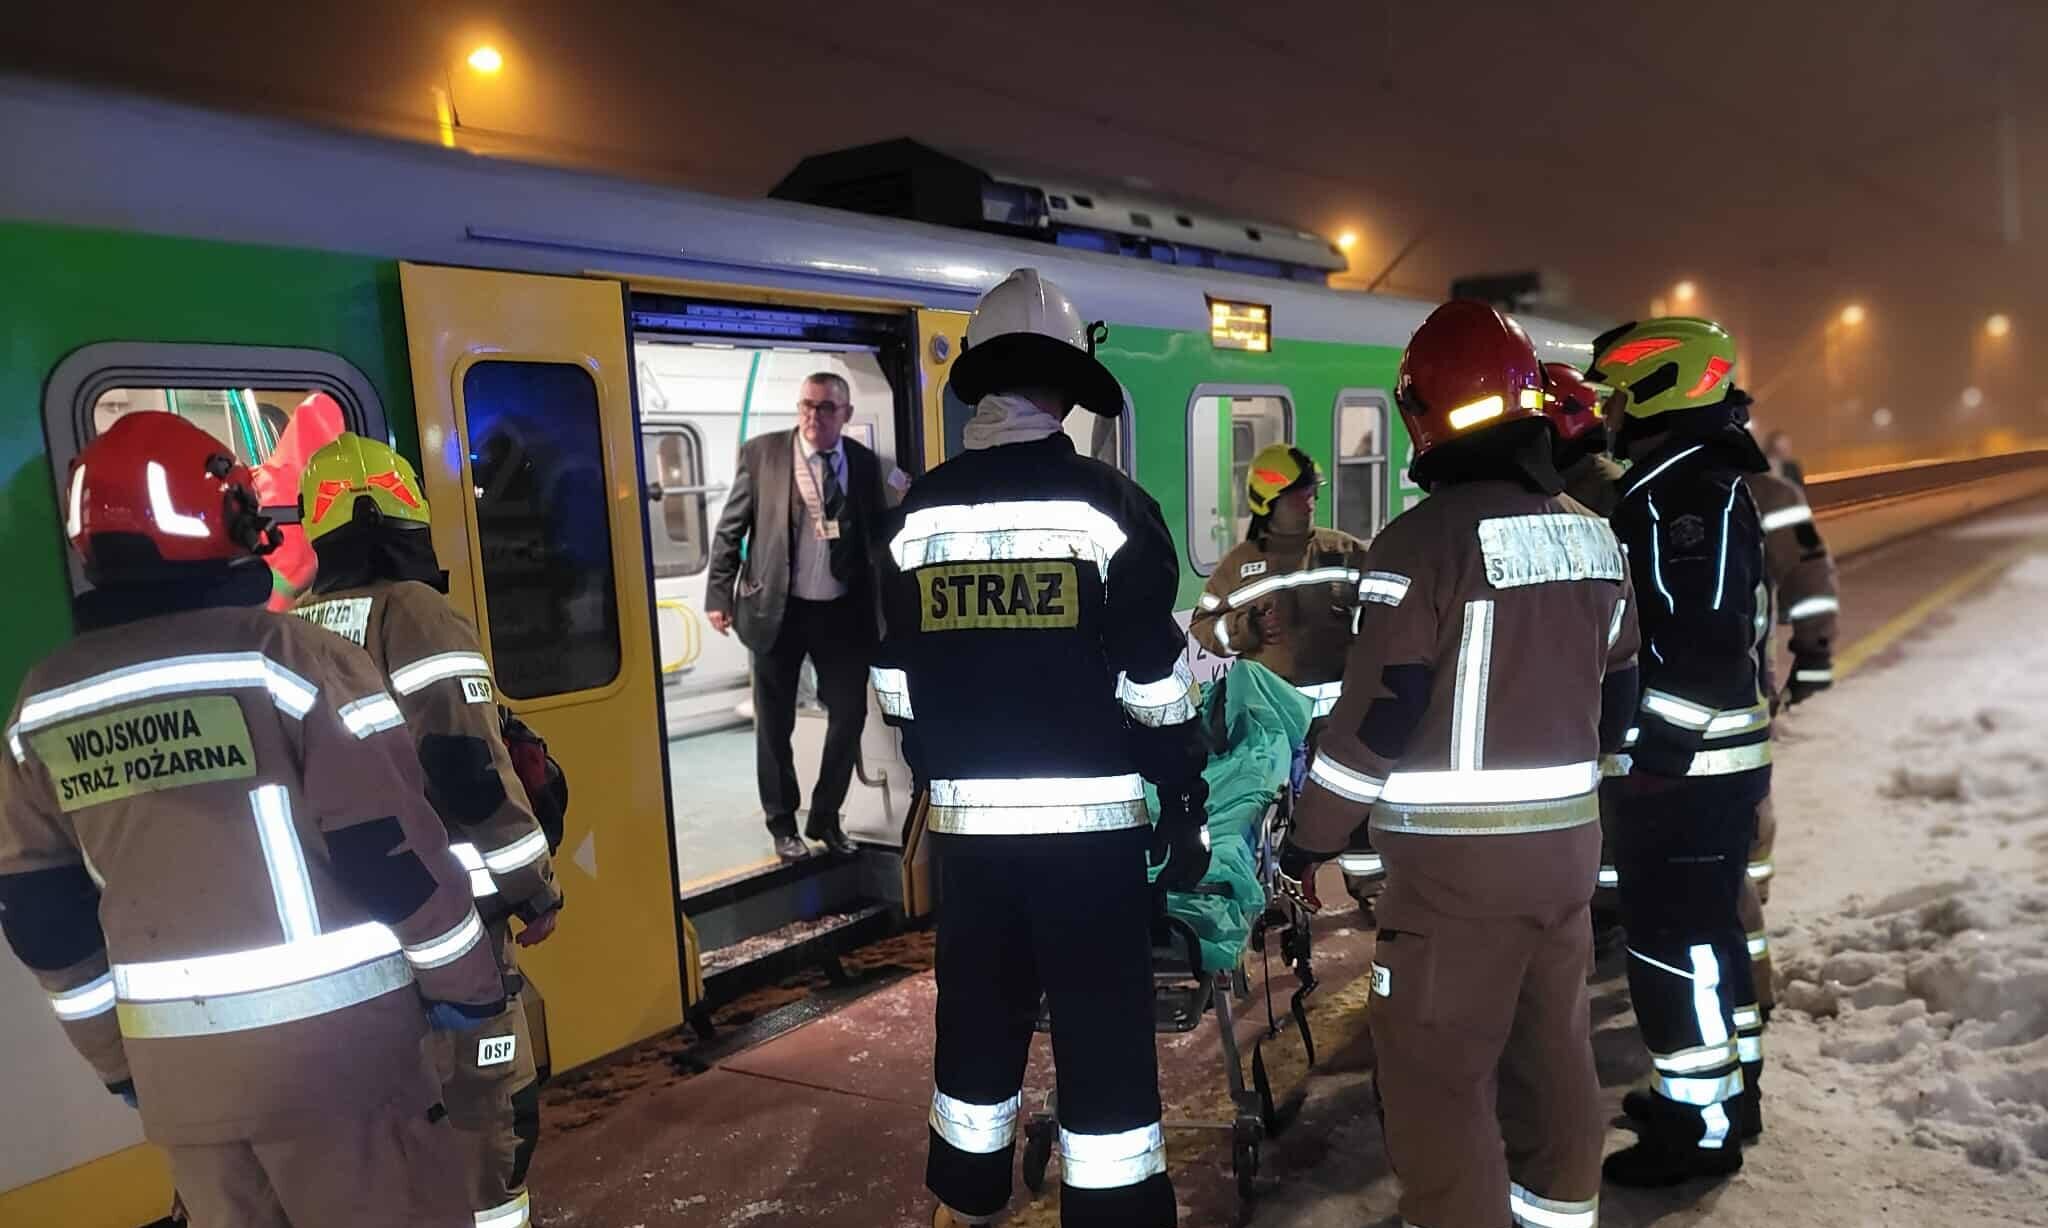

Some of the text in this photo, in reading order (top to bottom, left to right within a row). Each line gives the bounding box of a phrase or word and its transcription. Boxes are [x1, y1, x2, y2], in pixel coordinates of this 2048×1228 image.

[467, 681, 490, 698] OSP
[67, 709, 202, 763] WOJSKOWA
[60, 744, 247, 801] STRAŻ POŻARNA
[484, 1041, 511, 1060] OSP
